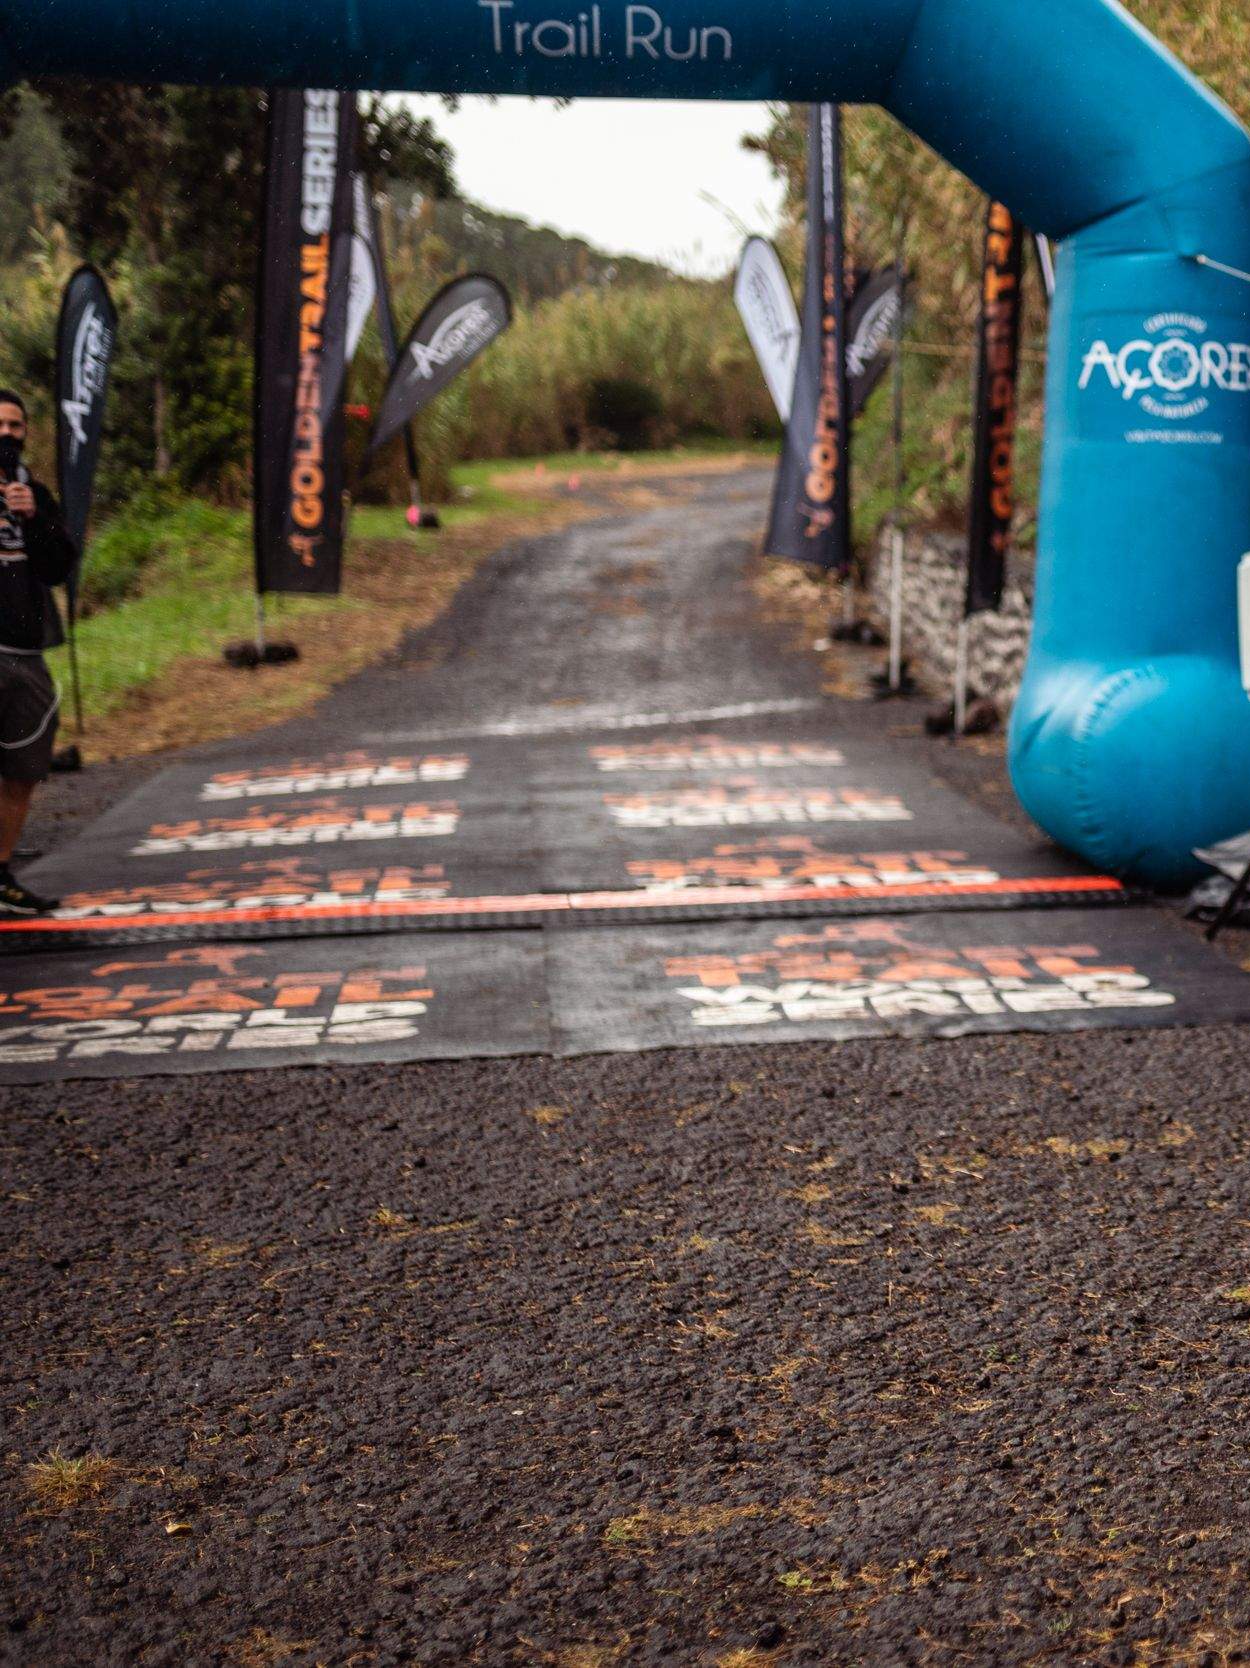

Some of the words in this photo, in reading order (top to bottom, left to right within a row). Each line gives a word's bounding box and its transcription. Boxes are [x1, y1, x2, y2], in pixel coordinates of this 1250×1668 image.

[477, 0, 600, 58] Trail
[625, 4, 733, 59] Run
[301, 88, 339, 235] SERIES
[299, 233, 330, 353] TRAIL
[289, 351, 323, 529] GOLDEN
